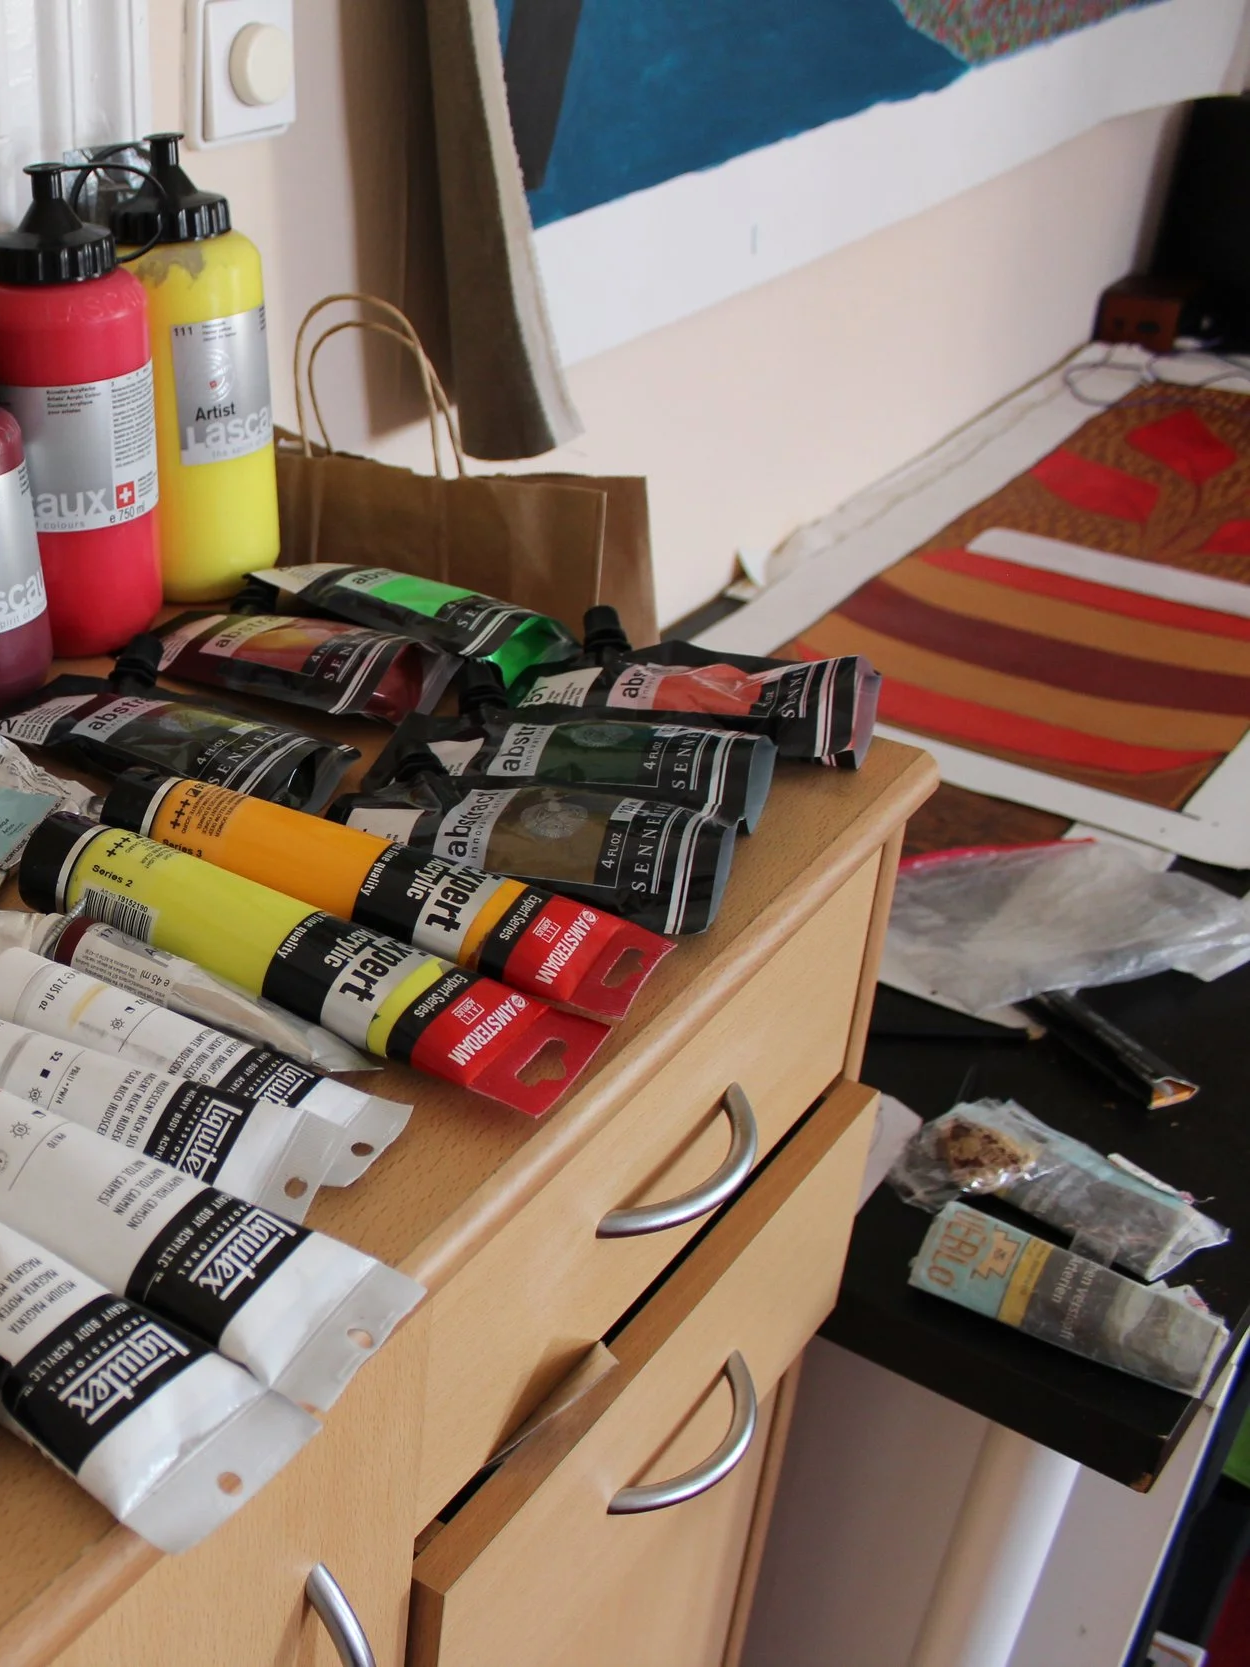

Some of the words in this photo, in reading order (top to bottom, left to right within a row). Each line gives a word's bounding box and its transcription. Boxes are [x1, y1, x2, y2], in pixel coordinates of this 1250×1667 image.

[174, 327, 193, 337] 111
[195, 403, 236, 421] Artist
[119, 507, 135, 521] 750
[136, 503, 145, 514] ml
[643, 761, 656, 770] 4
[444, 791, 499, 858] abstract
[384, 846, 401, 862] fine
[607, 832, 622, 857] FL/OZ
[92, 864, 125, 885] Series
[126, 879, 134, 888] 2
[601, 859, 615, 869] 4
[361, 861, 386, 897] quality
[406, 857, 453, 900] Acrylic
[117, 894, 149, 913] 19152190
[522, 894, 543, 918] Expert
[499, 914, 526, 940] Series
[277, 926, 308, 959] quality
[324, 929, 378, 968] Acrylic
[535, 916, 591, 985] AMSTERDAM
[437, 973, 468, 997] Expert
[414, 993, 445, 1018] Series
[447, 1000, 518, 1067] AMSTERDAM
[117, 1084, 130, 1104] RICO
[125, 1094, 140, 1115] RICHE
[143, 1080, 169, 1116] IRIDESCENT
[178, 1090, 196, 1112] HEAVY
[135, 1114, 148, 1133] RICH
[166, 1111, 183, 1133] BODY
[112, 1190, 143, 1217] CARMIN
[155, 1175, 186, 1206] NAPHTHOL
[126, 1201, 159, 1232] CRIMSON
[191, 1207, 217, 1231] BODY
[155, 1227, 196, 1269] ACRYLIC
[192, 1208, 298, 1301] Liquitex
[6, 1256, 44, 1286] MAGENTA
[21, 1268, 60, 1296] MAGENTA
[1052, 1254, 1085, 1304] Arterien
[46, 1280, 78, 1306] MEDIUM
[7, 1303, 48, 1336] MAGENTA
[99, 1302, 132, 1323] HEAVY
[73, 1318, 103, 1342] BODY
[27, 1341, 75, 1384] ACRYLIC
[47, 1314, 148, 1394] PROFESSIONAL
[57, 1321, 191, 1427] Liquitex
